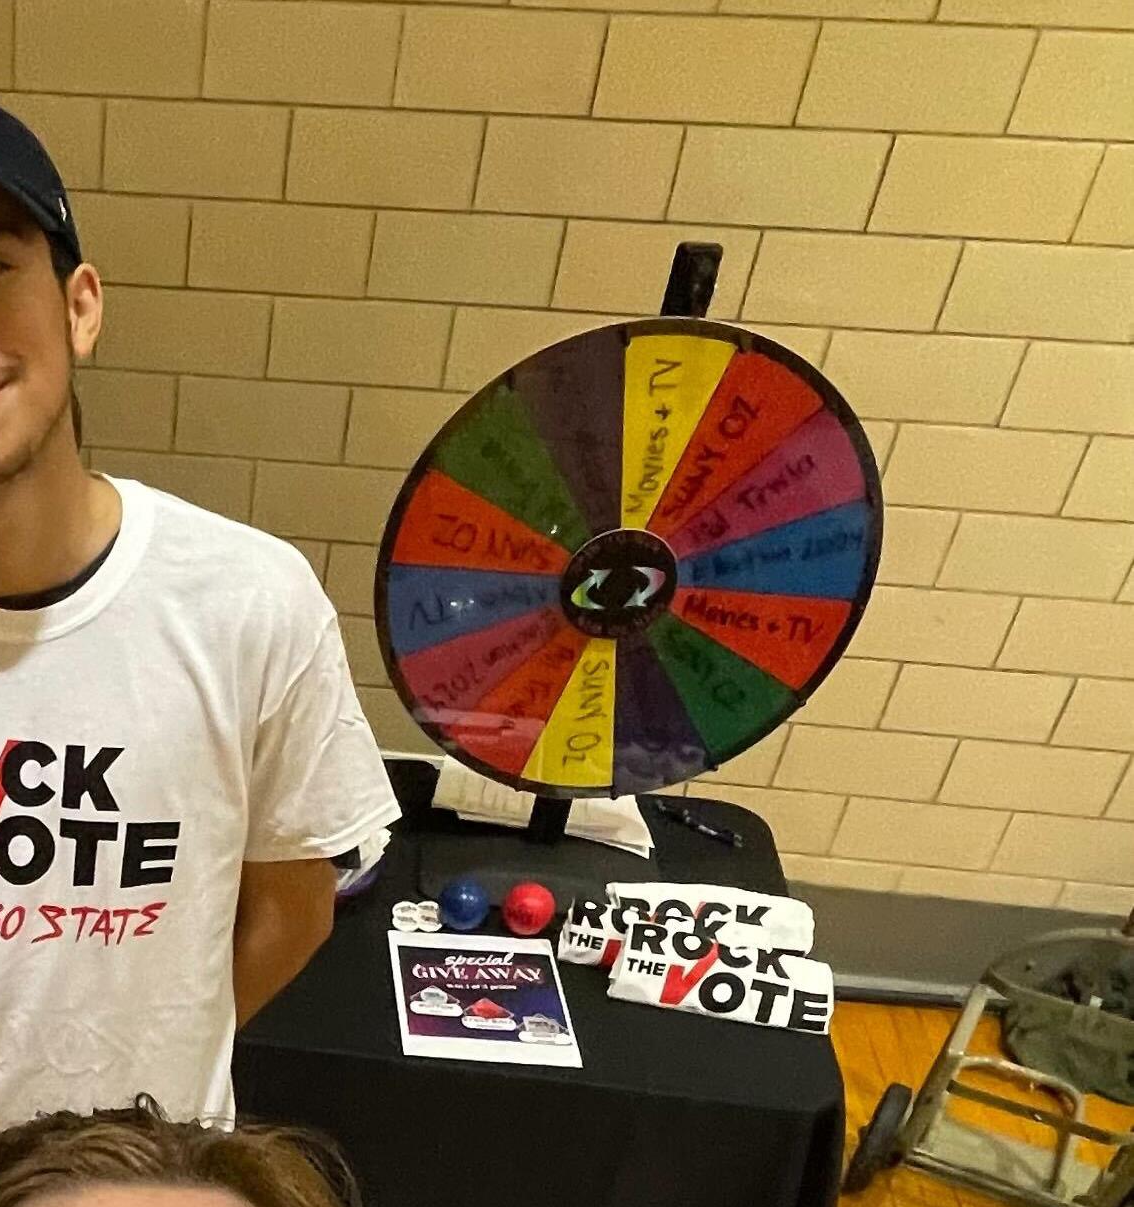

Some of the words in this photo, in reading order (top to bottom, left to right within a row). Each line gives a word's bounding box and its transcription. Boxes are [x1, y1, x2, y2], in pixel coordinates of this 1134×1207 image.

[626, 427, 669, 514] Movies
[649, 358, 682, 397] TV
[787, 613, 824, 643] TV
[575, 658, 609, 723] SUNY
[30, 902, 168, 947] STATE
[569, 931, 604, 950] THE
[412, 963, 468, 981] GIVE
[474, 966, 543, 983] AWAY
[444, 951, 514, 970] special
[627, 957, 666, 977] THE
[658, 942, 829, 1032] VOTE
